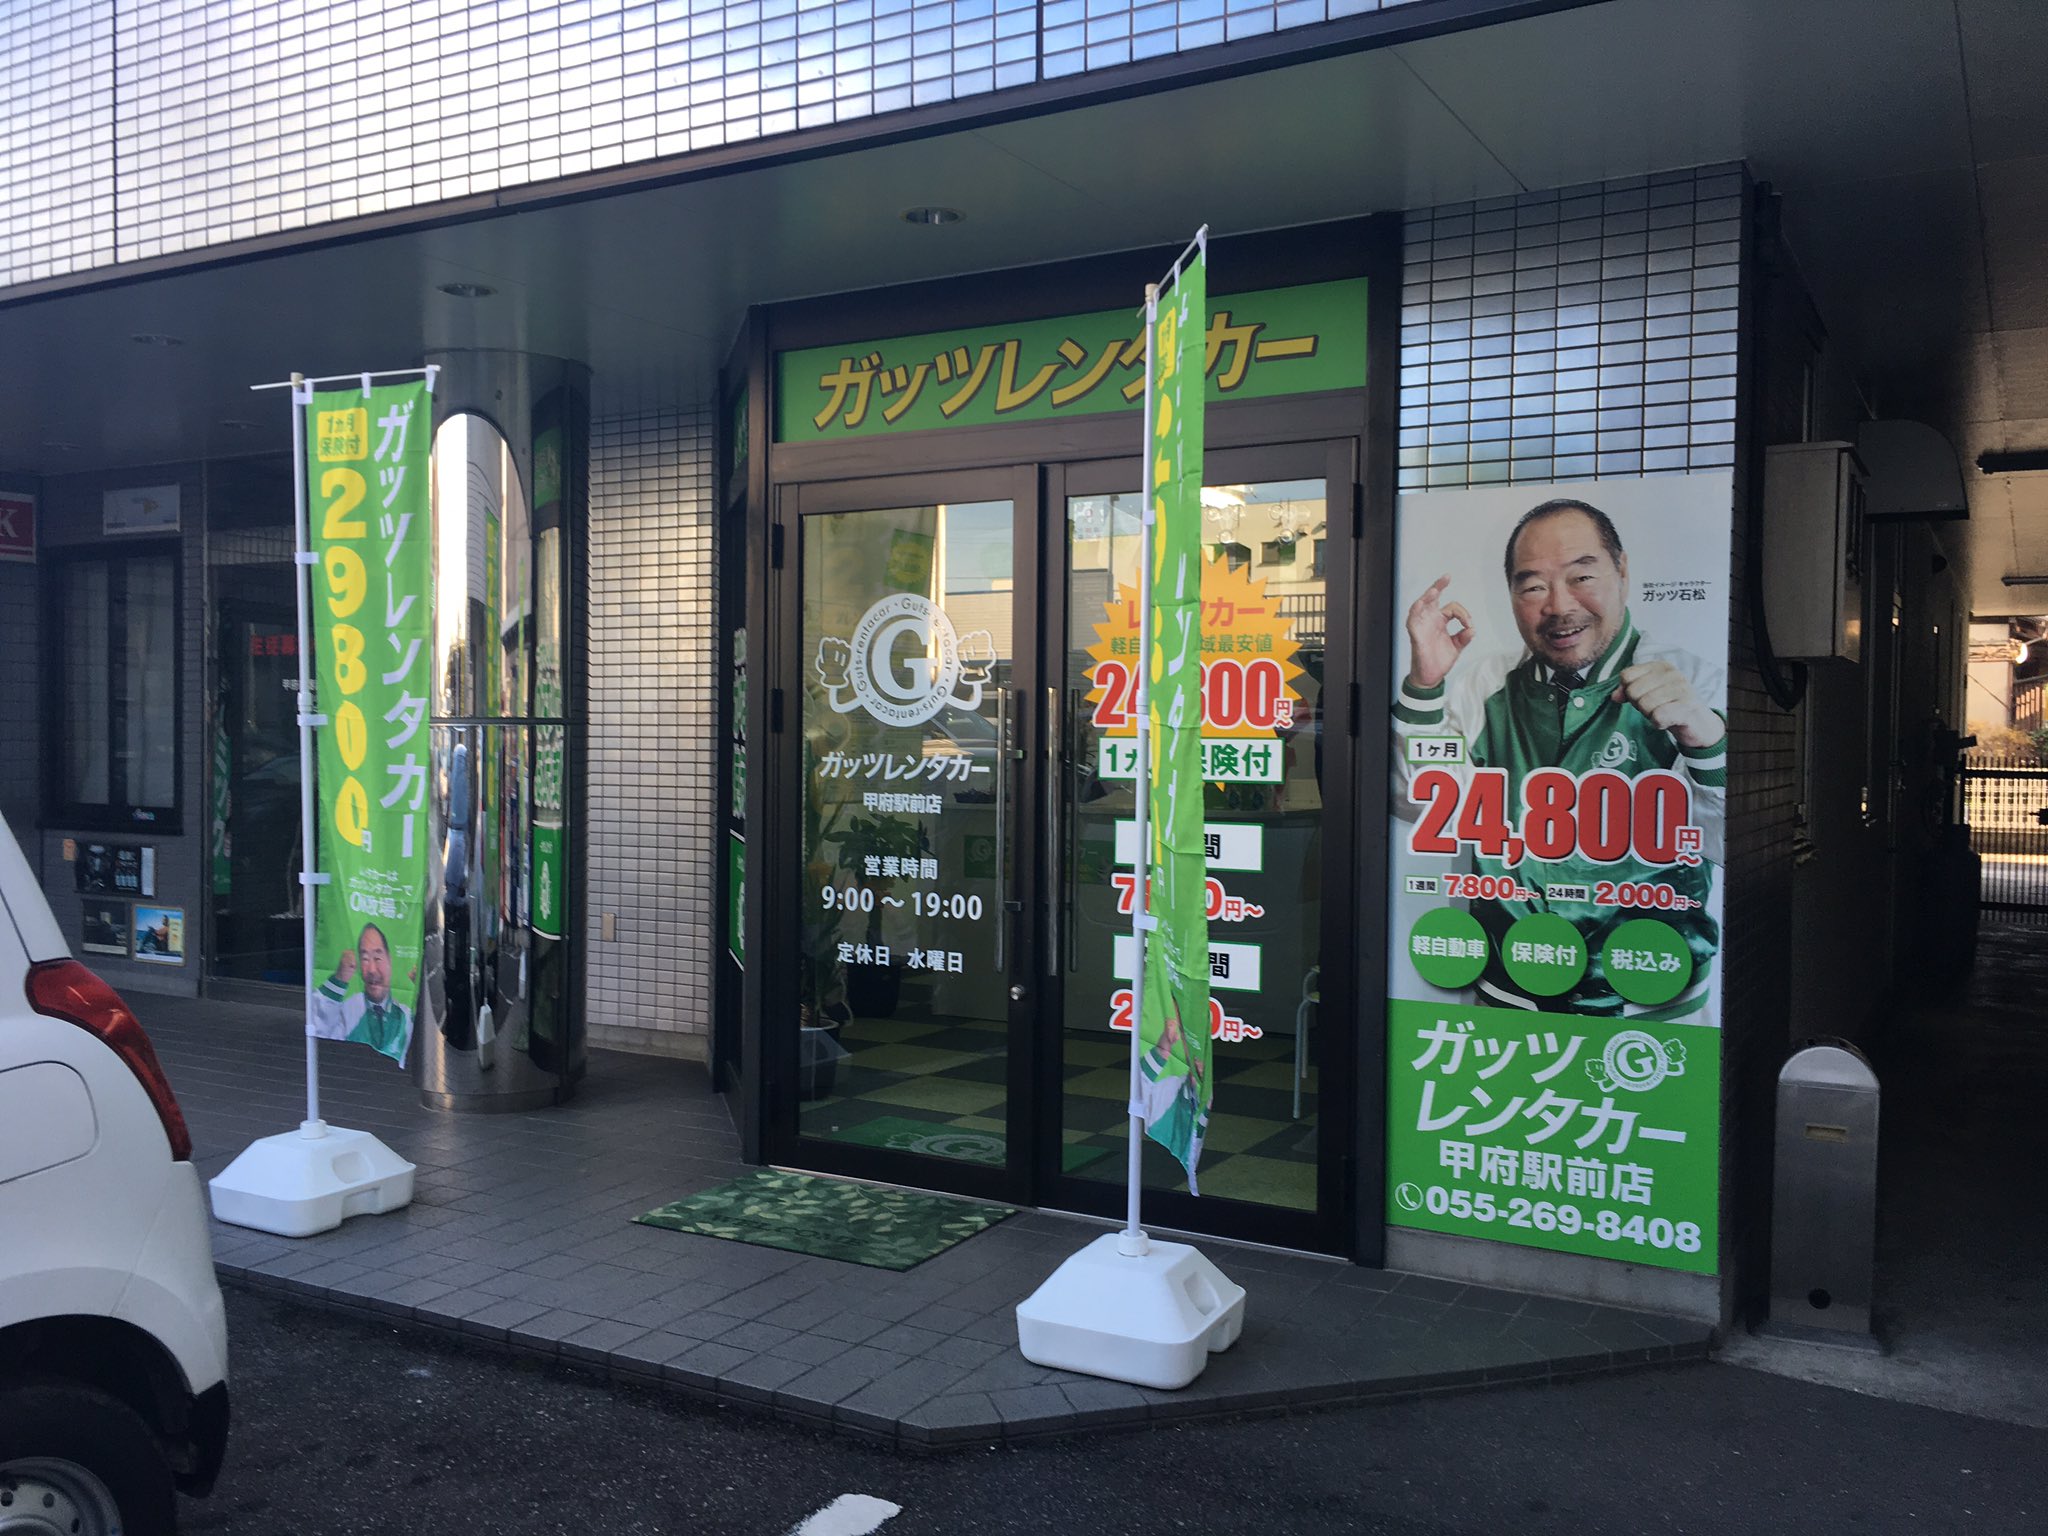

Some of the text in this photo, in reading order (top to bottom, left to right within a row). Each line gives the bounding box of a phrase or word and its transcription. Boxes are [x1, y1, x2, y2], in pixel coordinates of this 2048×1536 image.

[1642, 588, 1706, 602] ガッツ石松
[374, 400, 428, 857] ガッツレンタカー
[871, 618, 941, 700] G
[820, 750, 990, 782] ガッツレンタカー
[863, 792, 942, 814] 甲府駅前店
[864, 855, 938, 880] 営業時間
[821, 886, 874, 912] 9:00
[911, 892, 982, 921] 19:00
[1409, 880, 1437, 893] 1週間
[1548, 886, 1587, 900] 24時間
[837, 942, 963, 973] 定休日 水曜日
[1412, 935, 1486, 959] 軽自動車
[1511, 941, 1577, 967] 保険付
[1611, 949, 1681, 973] 税込み
[1411, 1019, 1588, 1084] ガッツ
[1616, 1041, 1654, 1078] G
[1417, 1080, 1687, 1154] レンタカー
[1439, 1139, 1654, 1206] 甲府駅前店
[1426, 1185, 1702, 1253] 055-269-8408
